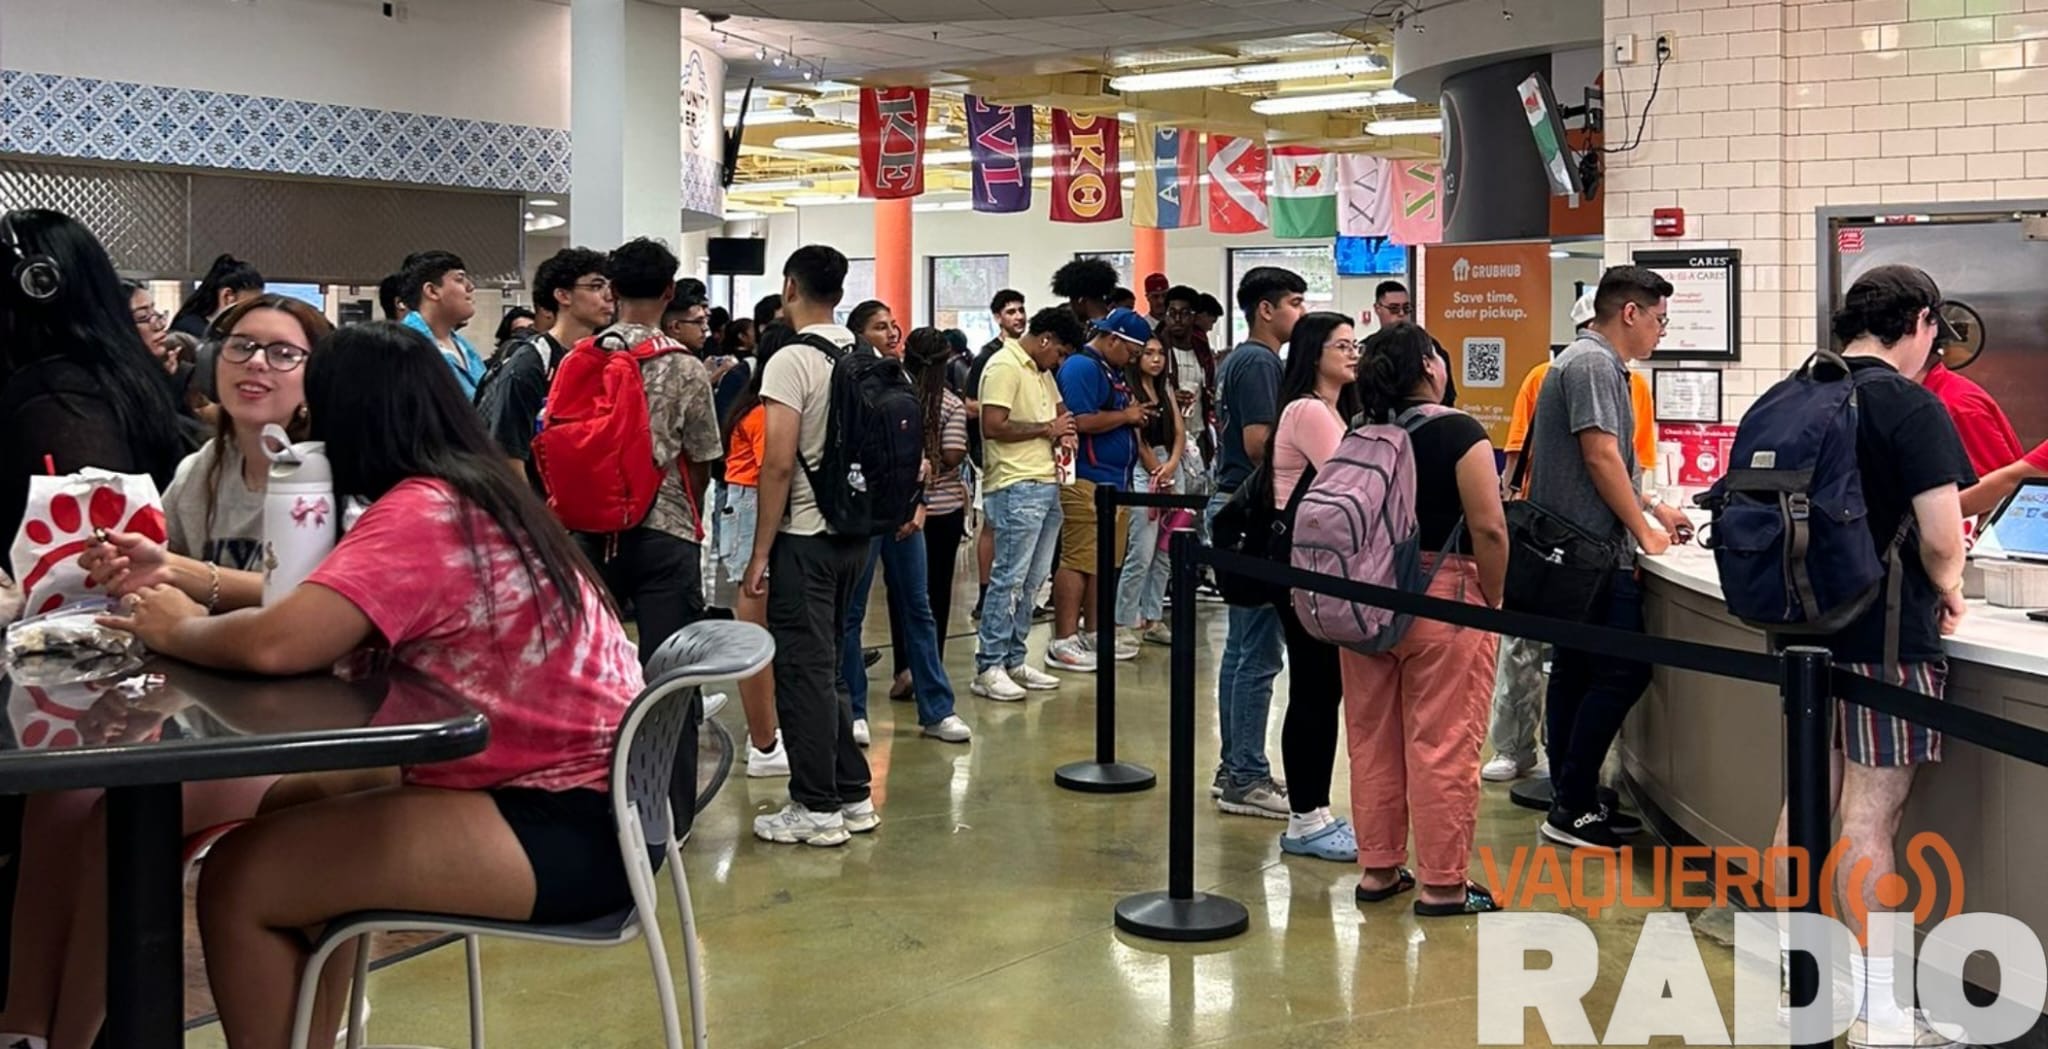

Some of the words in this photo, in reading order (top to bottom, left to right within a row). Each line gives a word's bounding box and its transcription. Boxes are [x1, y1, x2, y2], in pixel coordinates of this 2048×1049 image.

[1471, 263, 1521, 279] GRUBHUB
[1453, 291, 1484, 304] Save
[1486, 289, 1518, 304] time,
[1444, 306, 1477, 319] order
[1479, 305, 1527, 321] pickup.
